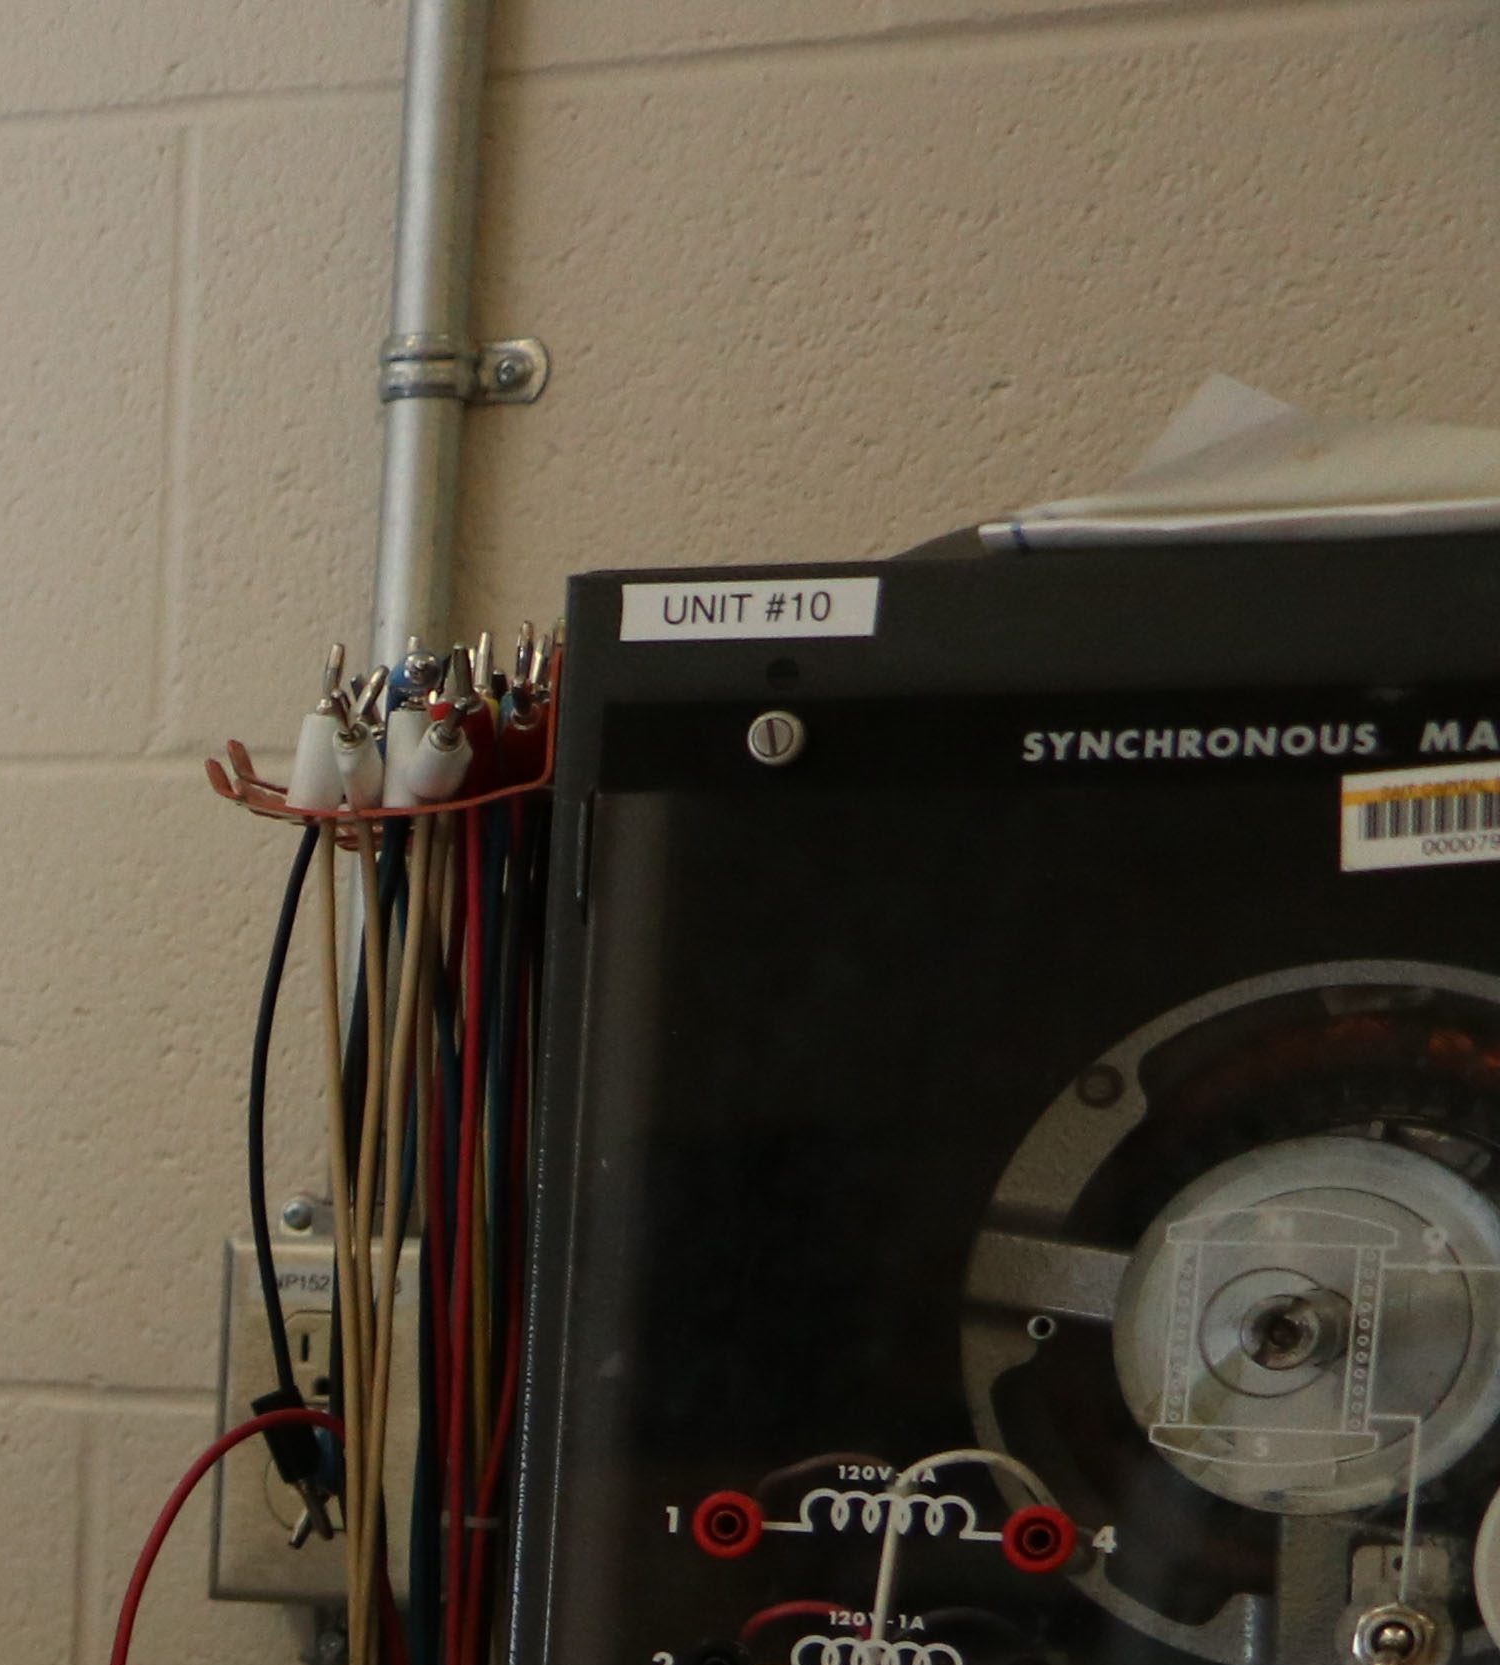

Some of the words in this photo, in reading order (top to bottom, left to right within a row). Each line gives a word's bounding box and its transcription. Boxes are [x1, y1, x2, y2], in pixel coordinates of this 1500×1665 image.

[663, 594, 754, 627] UNIT
[764, 591, 833, 624] #10
[1022, 722, 1380, 763] SYNCHRONOUS
[838, 1464, 892, 1482] 120V
[666, 1506, 680, 1534] 1
[1092, 1526, 1117, 1554] 4
[898, 1614, 925, 1632] 1A
